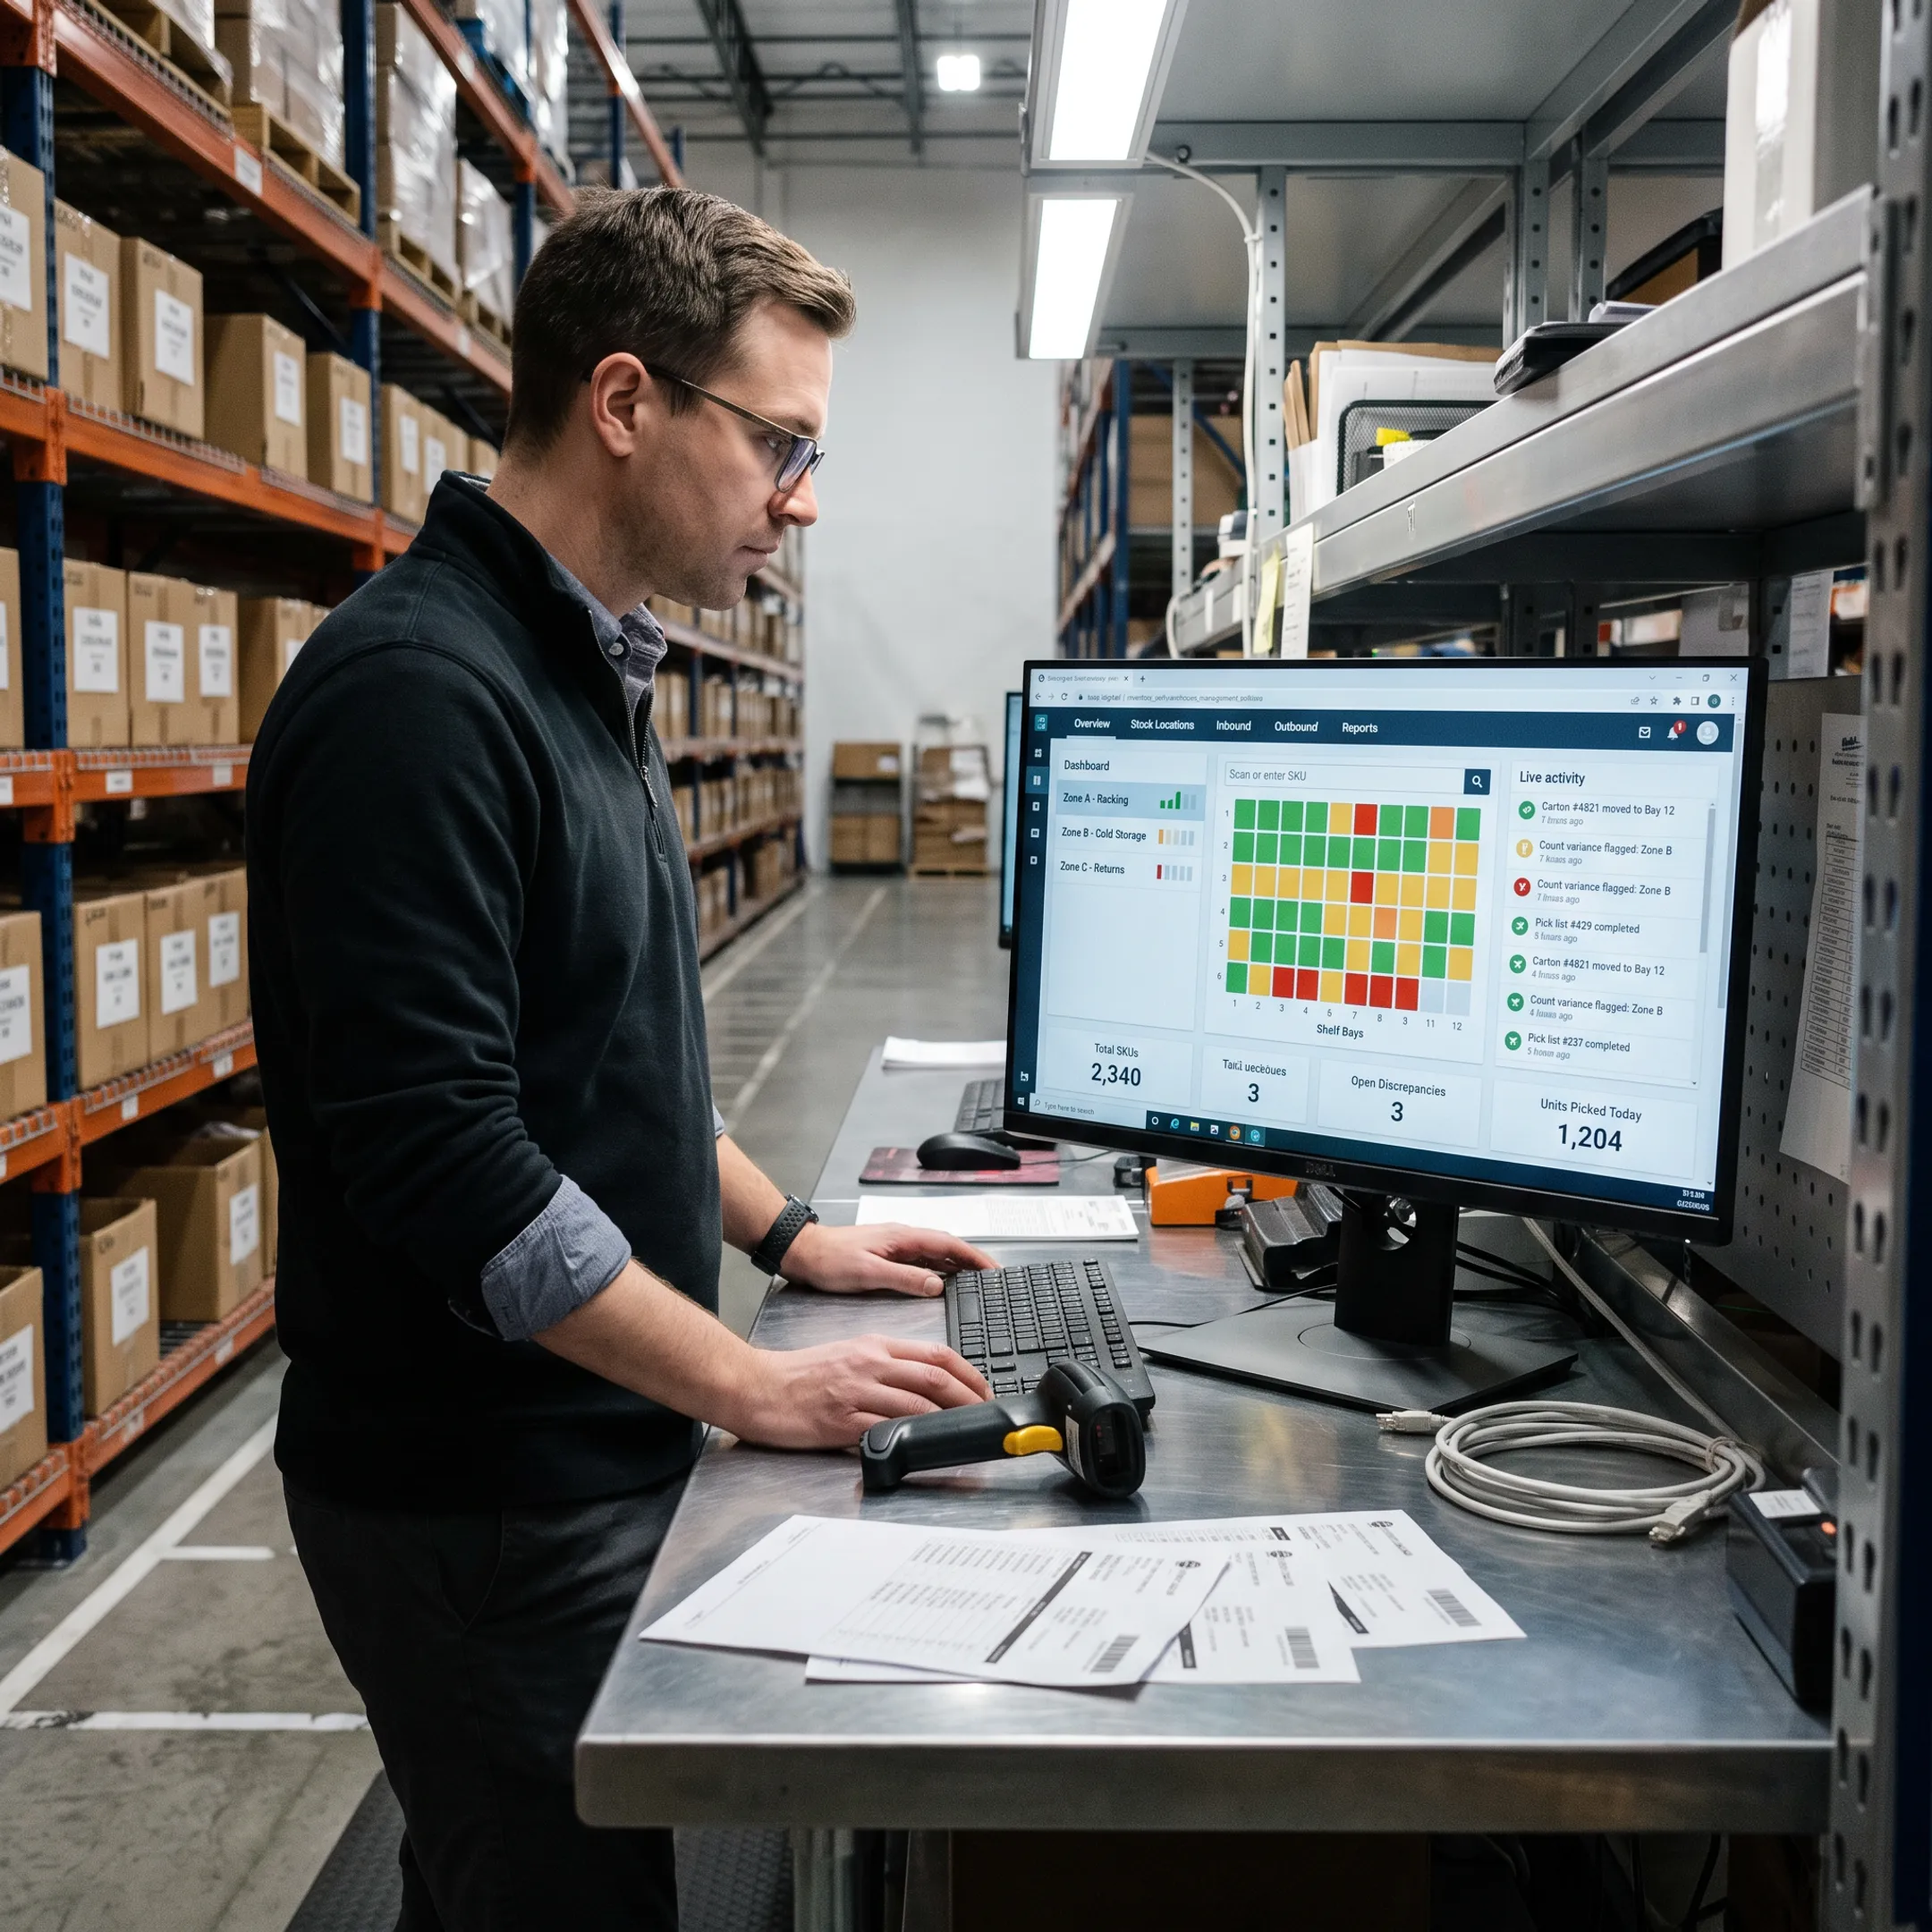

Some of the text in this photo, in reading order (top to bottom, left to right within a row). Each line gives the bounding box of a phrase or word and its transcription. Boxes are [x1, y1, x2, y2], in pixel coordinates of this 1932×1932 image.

[1074, 718, 1110, 728] Overview
[1131, 719, 1194, 730] Stock Locations
[1216, 720, 1251, 731] Inbound
[1275, 721, 1318, 732] Outbound
[1342, 723, 1378, 734] Reports
[1064, 759, 1109, 771] Dashboard
[1229, 768, 1307, 781] Scan or enter SKU
[1520, 771, 1585, 787] Live activity
[1063, 792, 1082, 803] Zone
[1084, 793, 1090, 803] A
[1097, 794, 1129, 807] Racking
[1542, 801, 1674, 817] Carton #4821 moved to Bay 12
[1569, 818, 1584, 826] ago
[1062, 826, 1081, 836] Zone
[1083, 828, 1089, 837] B
[1096, 828, 1114, 838] Cold
[1115, 829, 1147, 843] Storage
[1539, 841, 1673, 855] Count variance flagged: Zone B
[1060, 860, 1080, 871] Zone
[1081, 862, 1088, 871] C
[1094, 863, 1124, 874] Returns
[1568, 857, 1582, 866] ago
[1538, 879, 1671, 895] Count variance flagged: Zone B
[1565, 895, 1580, 905] ago
[1535, 918, 1640, 934] Pick list #429 completed
[1563, 935, 1578, 944] ago
[1532, 956, 1665, 976] Carton #4821 moved to Bay 12
[1562, 973, 1575, 983] ago
[1530, 995, 1663, 1015] Count variance flagged: Zone B
[1303, 1006, 1309, 1014] 4
[1377, 1014, 1383, 1022] 8
[1453, 1022, 1462, 1030] 12
[1558, 1013, 1572, 1021] ago
[1317, 1023, 1364, 1039] Shelf Bays
[1528, 1033, 1631, 1052] Pick list #237 completed
[1095, 1043, 1139, 1057] Total SKUs
[1555, 1050, 1570, 1061] ago
[1091, 1063, 1141, 1087] 2,340
[1248, 1083, 1259, 1103] 3
[1352, 1075, 1446, 1097] Open Discrepancies
[1391, 1101, 1403, 1122] 3
[1540, 1097, 1642, 1123] Units Picked Today
[1558, 1123, 1623, 1151] 1,204
